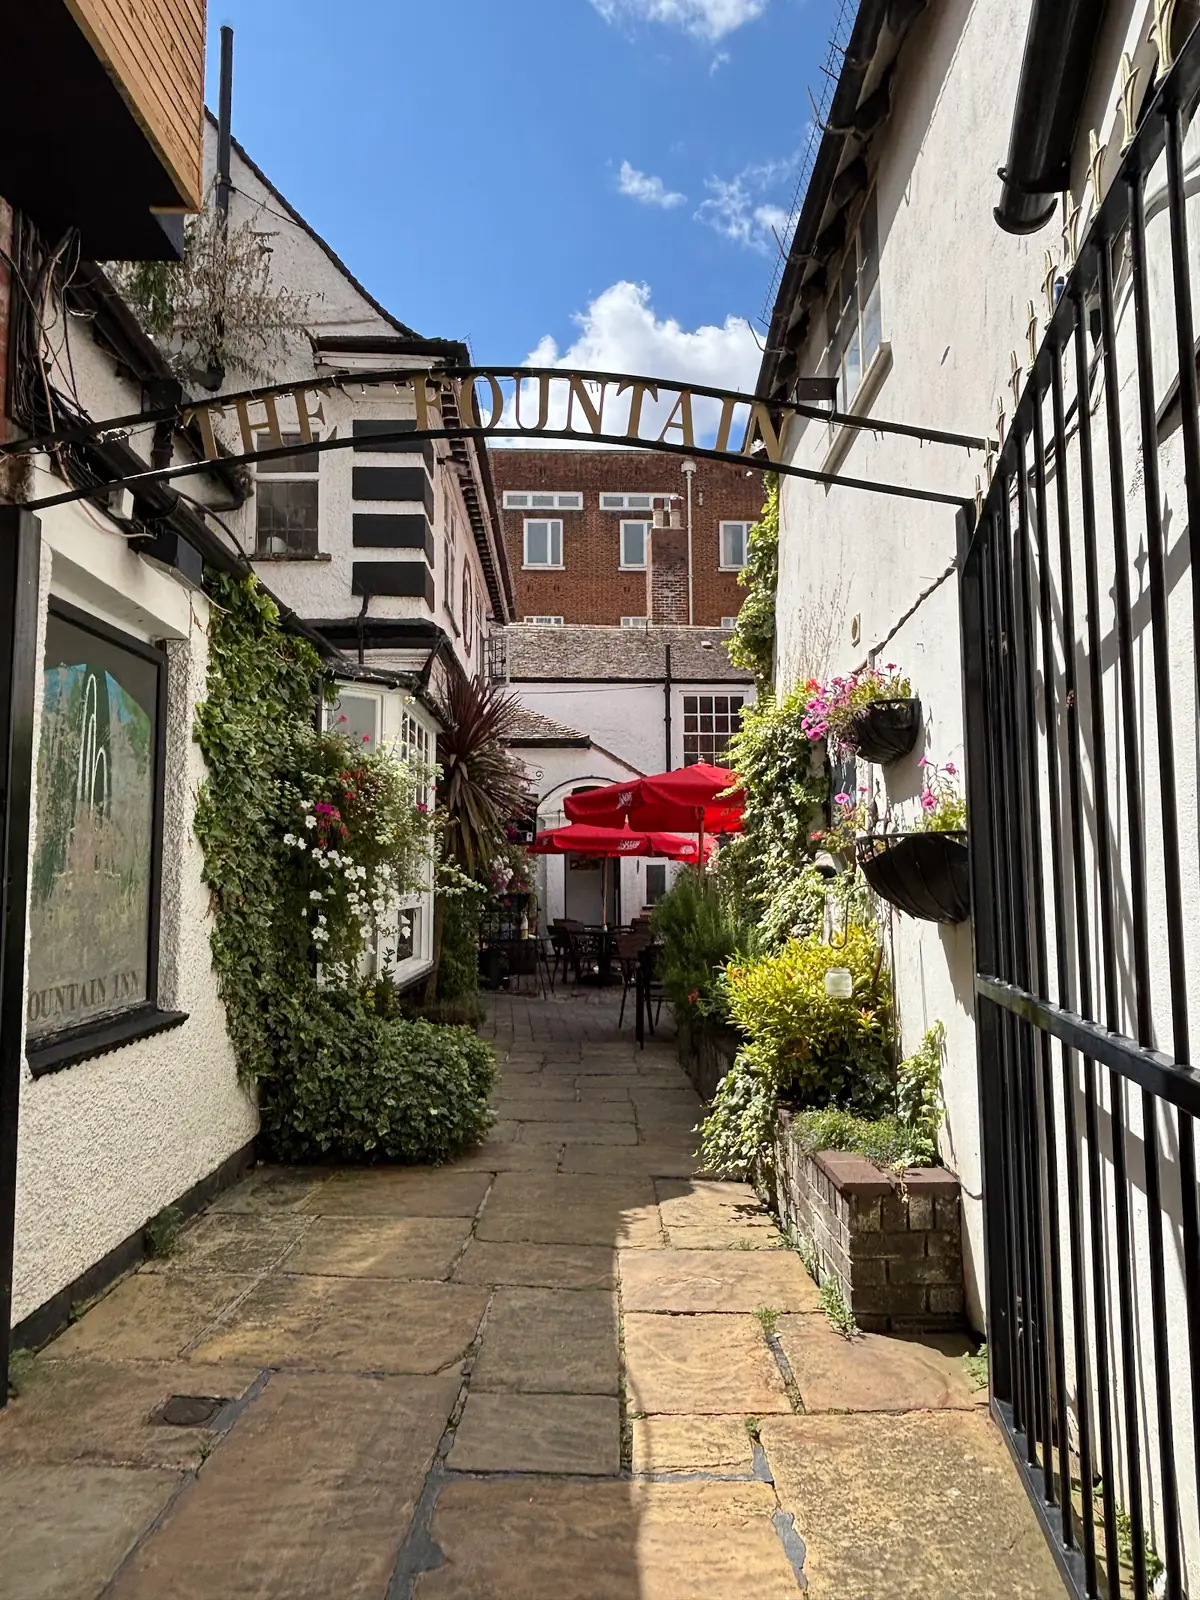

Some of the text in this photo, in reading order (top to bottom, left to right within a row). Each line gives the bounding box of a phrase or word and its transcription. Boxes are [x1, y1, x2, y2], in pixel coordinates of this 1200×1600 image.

[183, 370, 796, 464] THE FOUNTAIN
[27, 970, 141, 1021] OUNTAIN INN
